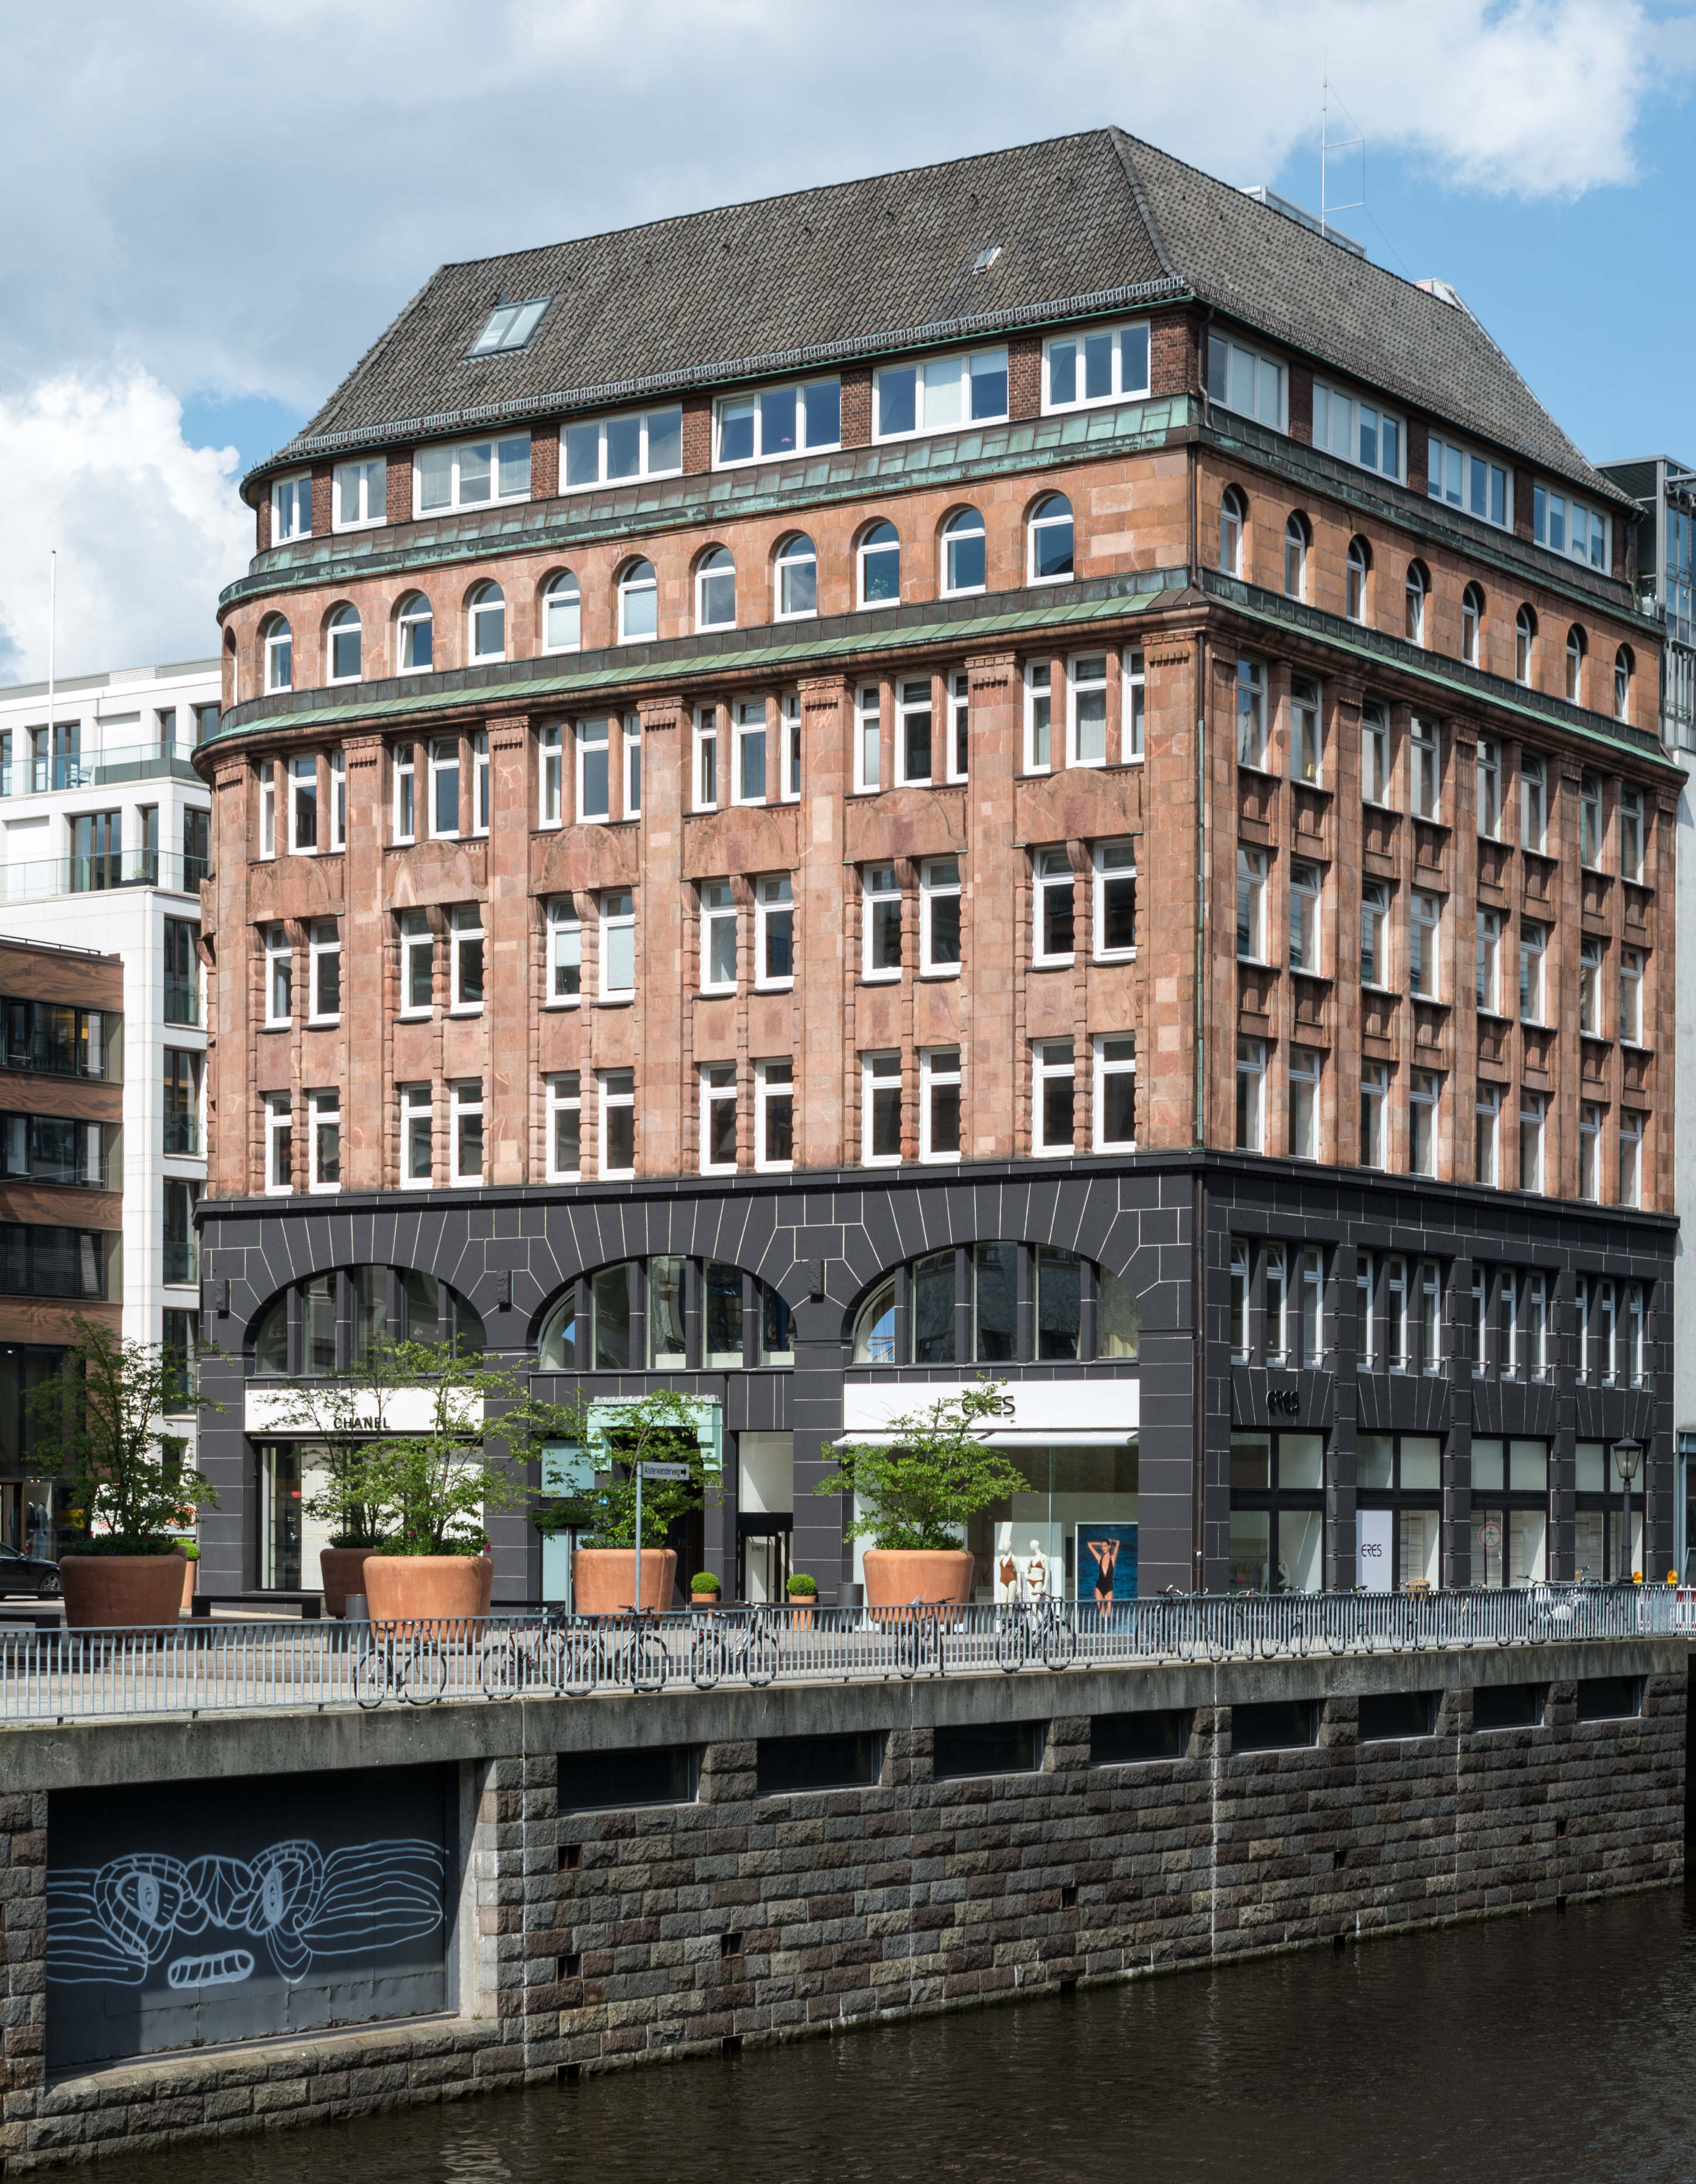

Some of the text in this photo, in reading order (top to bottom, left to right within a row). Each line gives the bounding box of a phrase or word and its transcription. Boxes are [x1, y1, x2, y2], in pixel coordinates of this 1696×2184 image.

[962, 1396, 1015, 1415] EES
[333, 1417, 391, 1428] CHANEL
[644, 1466, 680, 1478] Alsterwanderweg
[1361, 1544, 1382, 1557] ERES
